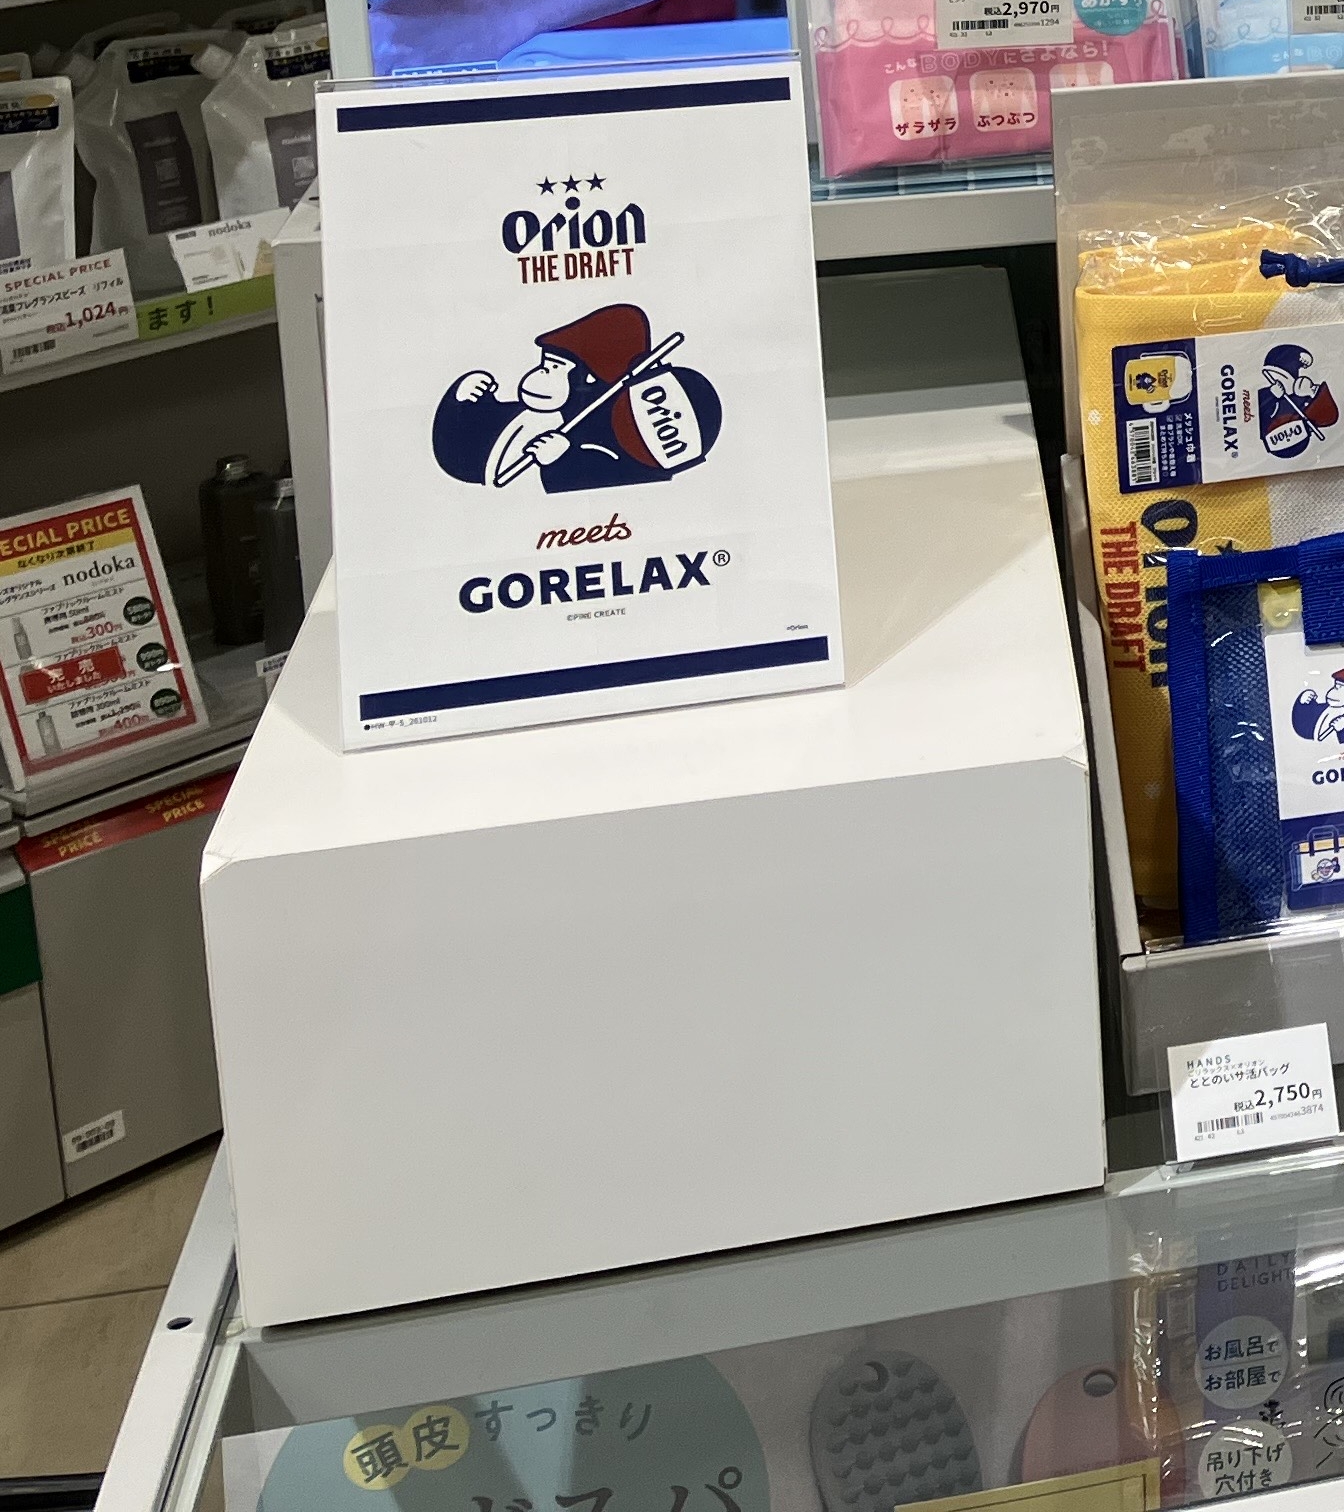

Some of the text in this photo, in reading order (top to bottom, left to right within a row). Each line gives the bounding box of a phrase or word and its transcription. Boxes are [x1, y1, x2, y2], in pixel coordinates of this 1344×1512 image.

[895, 110, 1037, 138] ザラザラ ぶつぶつ
[208, 219, 252, 238] nodoka
[501, 195, 647, 254] Orion
[5, 257, 113, 292] SPECIAL PRICE
[517, 248, 636, 284] THE DRAFT
[640, 383, 687, 458] Orion
[1241, 388, 1252, 423] meets
[66, 506, 132, 540] PRICE
[536, 512, 633, 552] meets
[62, 554, 136, 587] nodoka
[1100, 520, 1146, 673] THE DRAFT
[1186, 1054, 1232, 1070] HANDS
[1190, 1061, 1291, 1089] ととのいサ活バッグ
[1233, 1082, 1323, 1113] 税込2,750円
[1215, 1252, 1292, 1275] DAILY
[1203, 1335, 1281, 1362] お風呂で
[1203, 1364, 1283, 1393] お部屋で
[1205, 1443, 1287, 1473] 吊り下げ
[1214, 1467, 1277, 1493] 穴付き
